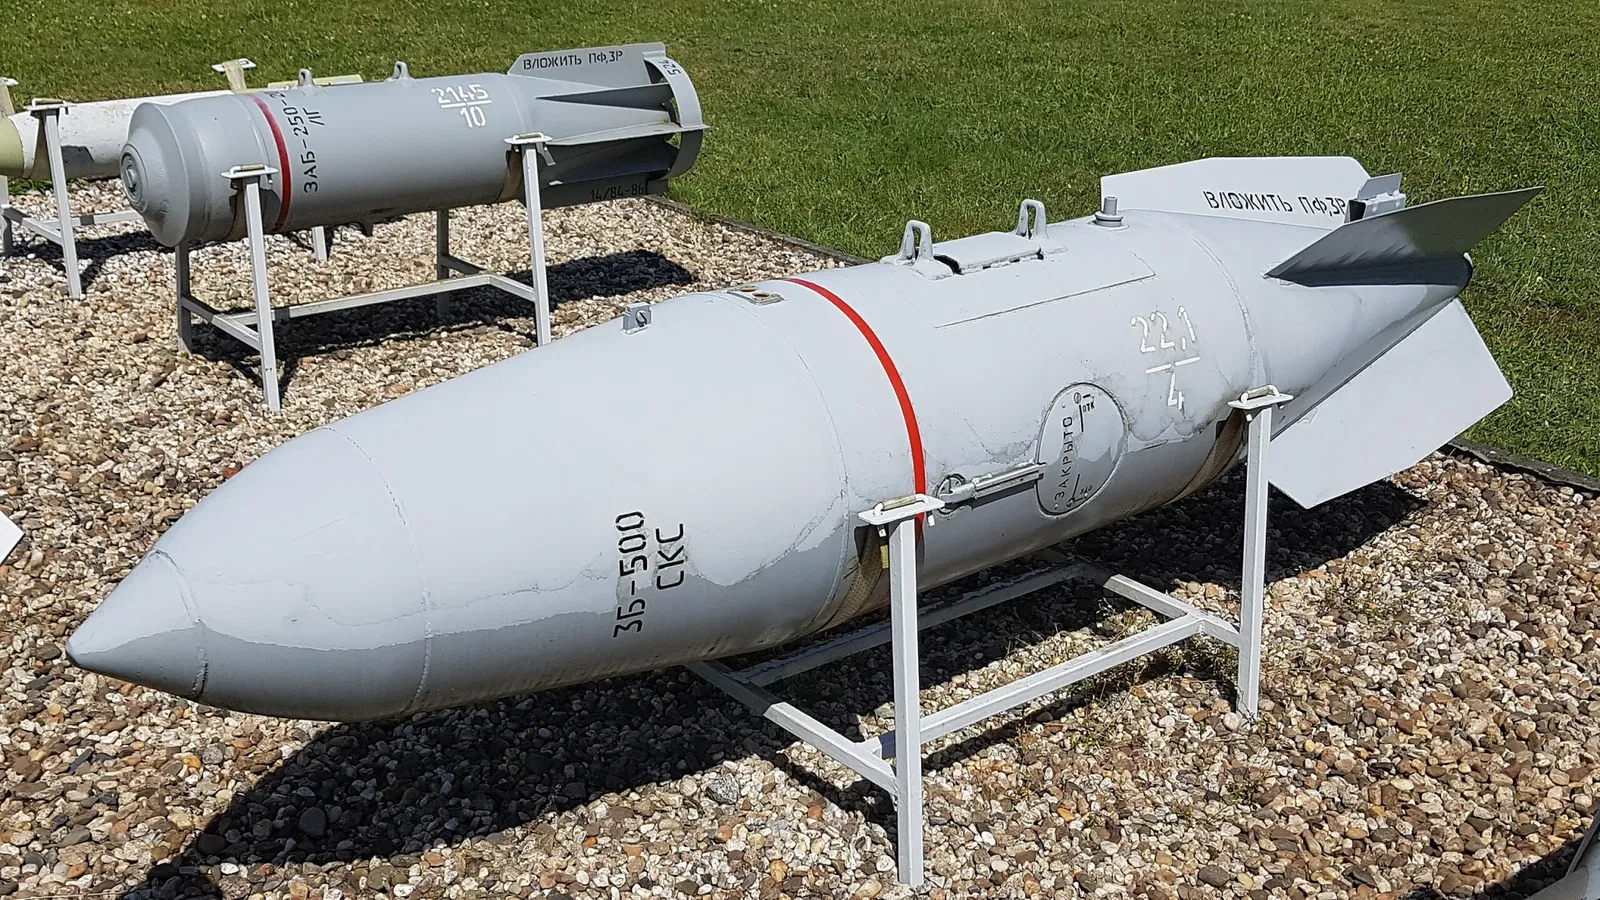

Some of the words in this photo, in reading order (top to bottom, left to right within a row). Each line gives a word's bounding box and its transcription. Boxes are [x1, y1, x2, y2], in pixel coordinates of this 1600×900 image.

[523, 54, 582, 70] ВЛОЖИТЬ
[460, 106, 486, 128] 10
[1202, 190, 1293, 213] ВЛОЖИТЬ
[1130, 306, 1196, 353] 22,1
[1167, 372, 1185, 411] 4
[1054, 416, 1074, 501] ЗАКРЫТО
[655, 523, 685, 591] СКС
